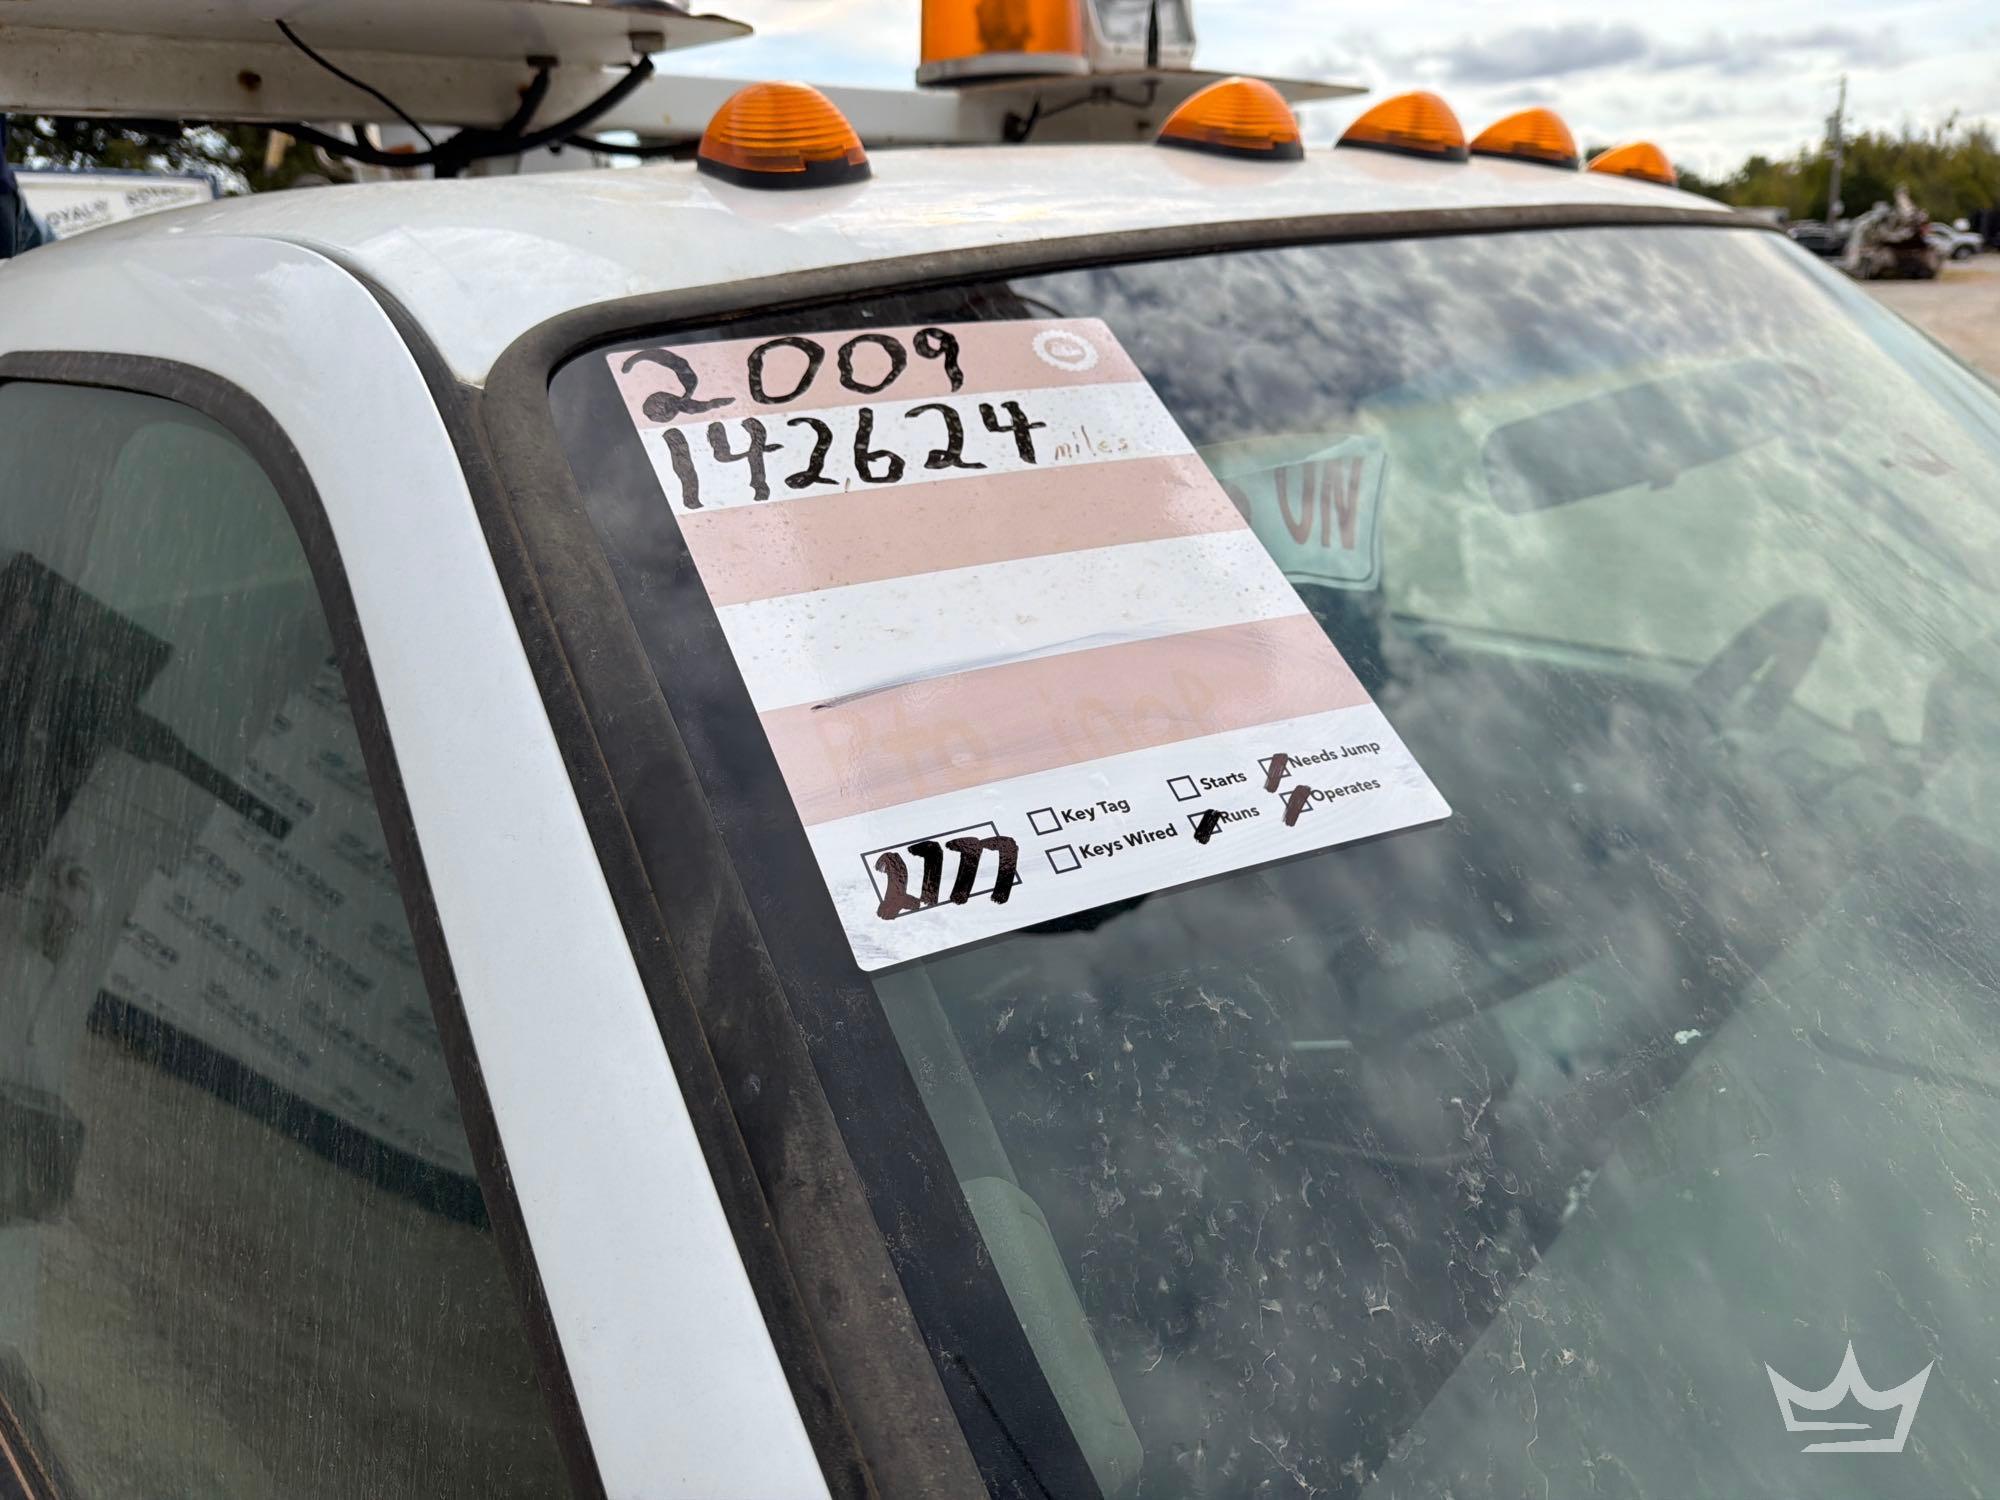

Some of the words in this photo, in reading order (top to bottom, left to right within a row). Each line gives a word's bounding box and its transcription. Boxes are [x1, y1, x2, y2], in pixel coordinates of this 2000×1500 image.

[621, 327, 964, 423] 2009
[662, 400, 1047, 509] 142624
[1055, 425, 1129, 460] miles
[1288, 749, 1338, 769] Needs
[1341, 741, 1381, 758] Jump
[1200, 771, 1248, 791] Starts
[1310, 777, 1381, 803] Operates
[1061, 806, 1097, 824] Key
[1096, 798, 1131, 817] Tag
[1219, 805, 1260, 824] Runs
[1079, 834, 1124, 860] Keys
[1123, 822, 1178, 850] Wired
[875, 836, 1019, 920] 2777
